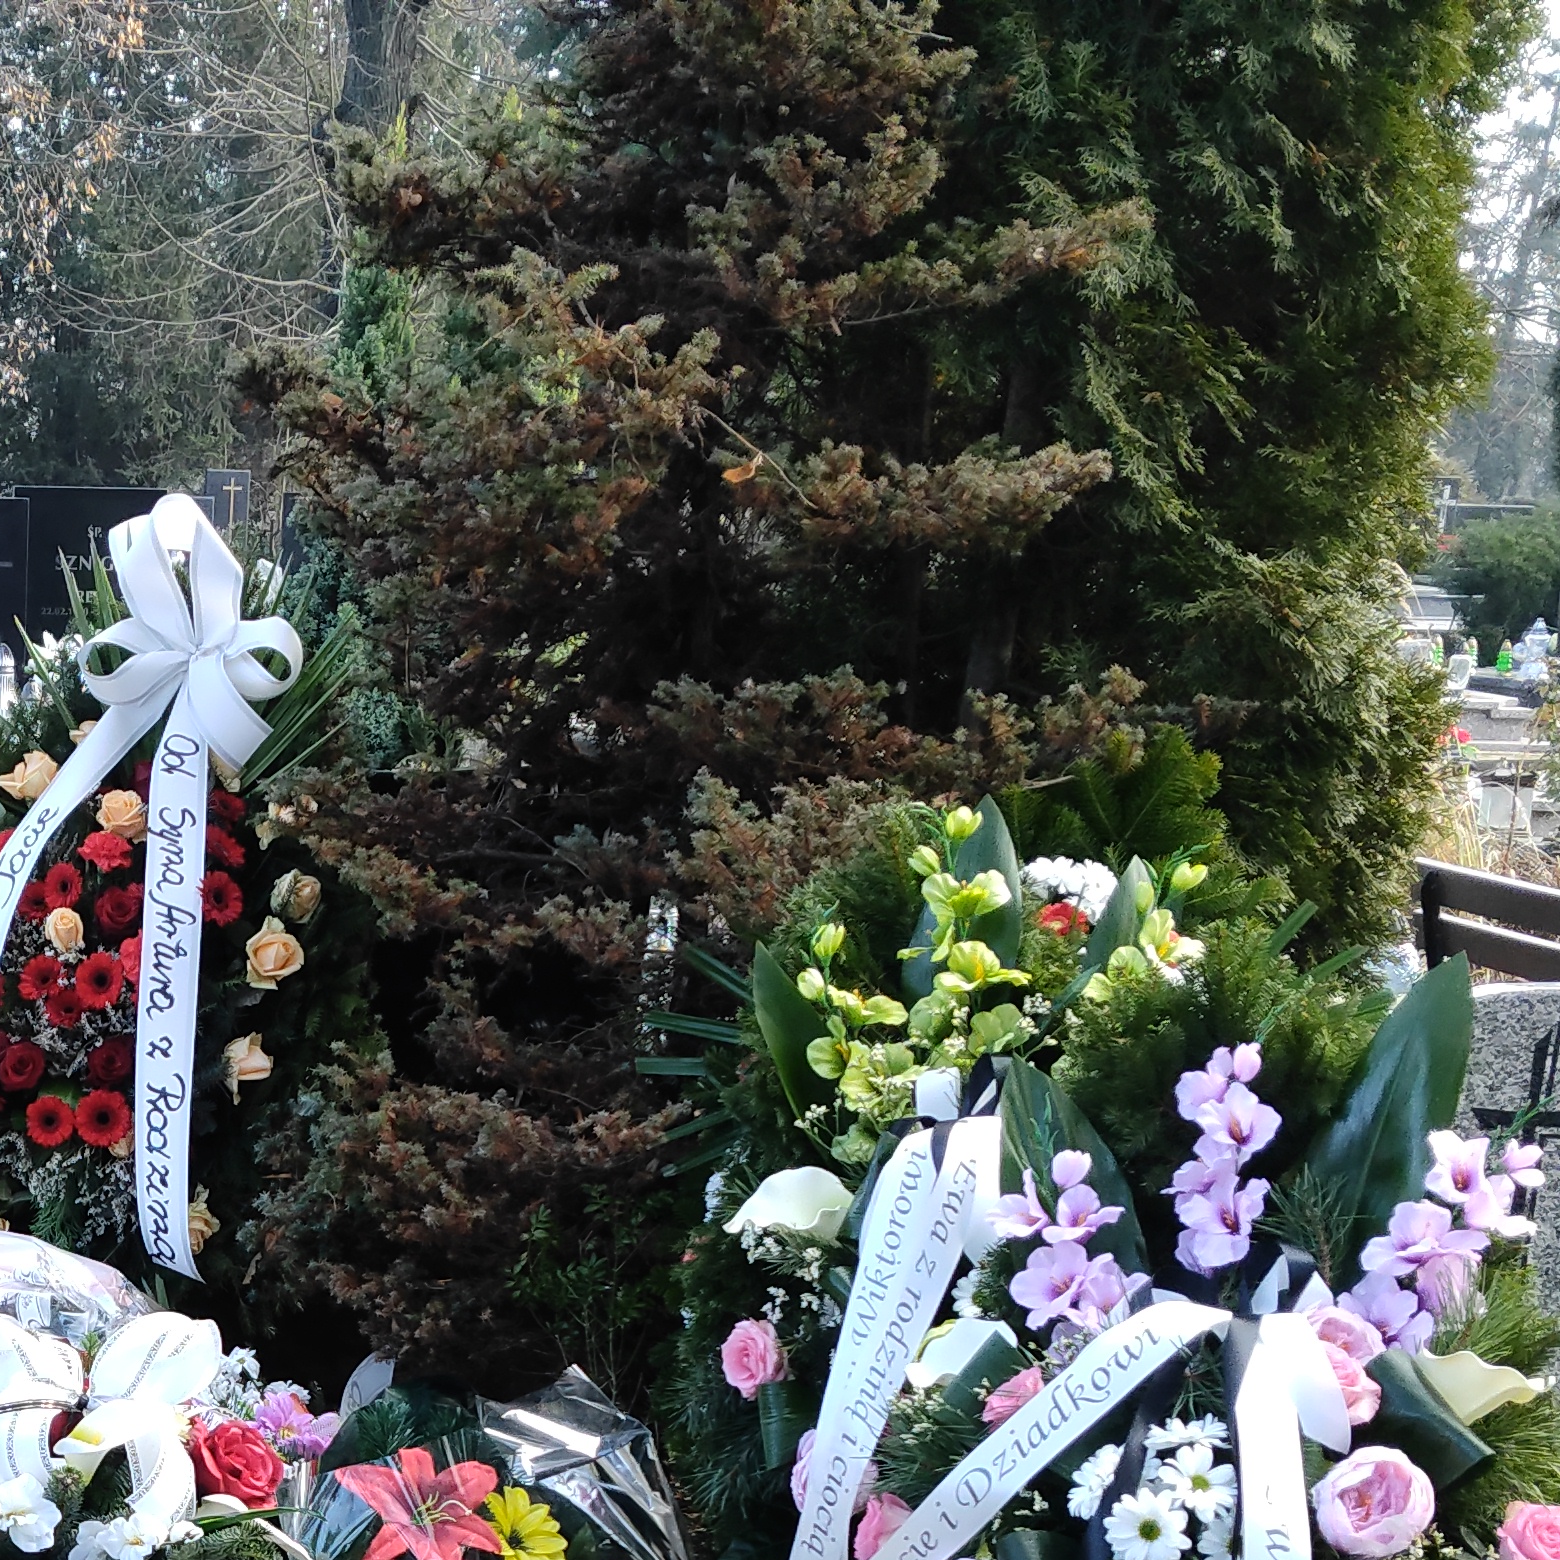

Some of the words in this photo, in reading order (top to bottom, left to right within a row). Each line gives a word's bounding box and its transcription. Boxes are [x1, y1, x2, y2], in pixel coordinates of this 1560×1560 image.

[159, 733, 200, 779] Od
[147, 806, 197, 894] Syna
[146, 888, 197, 1021] Artura
[146, 1035, 174, 1060] z
[930, 1158, 977, 1245] Ewa
[850, 1148, 930, 1347] Wiktorowi
[915, 1248, 938, 1279] z
[844, 1287, 922, 1427] rodziną
[841, 1432, 865, 1452] i
[935, 1500, 959, 1531] i
[955, 1326, 1162, 1509] Dziadkowi
[801, 1454, 850, 1558] ciocią
